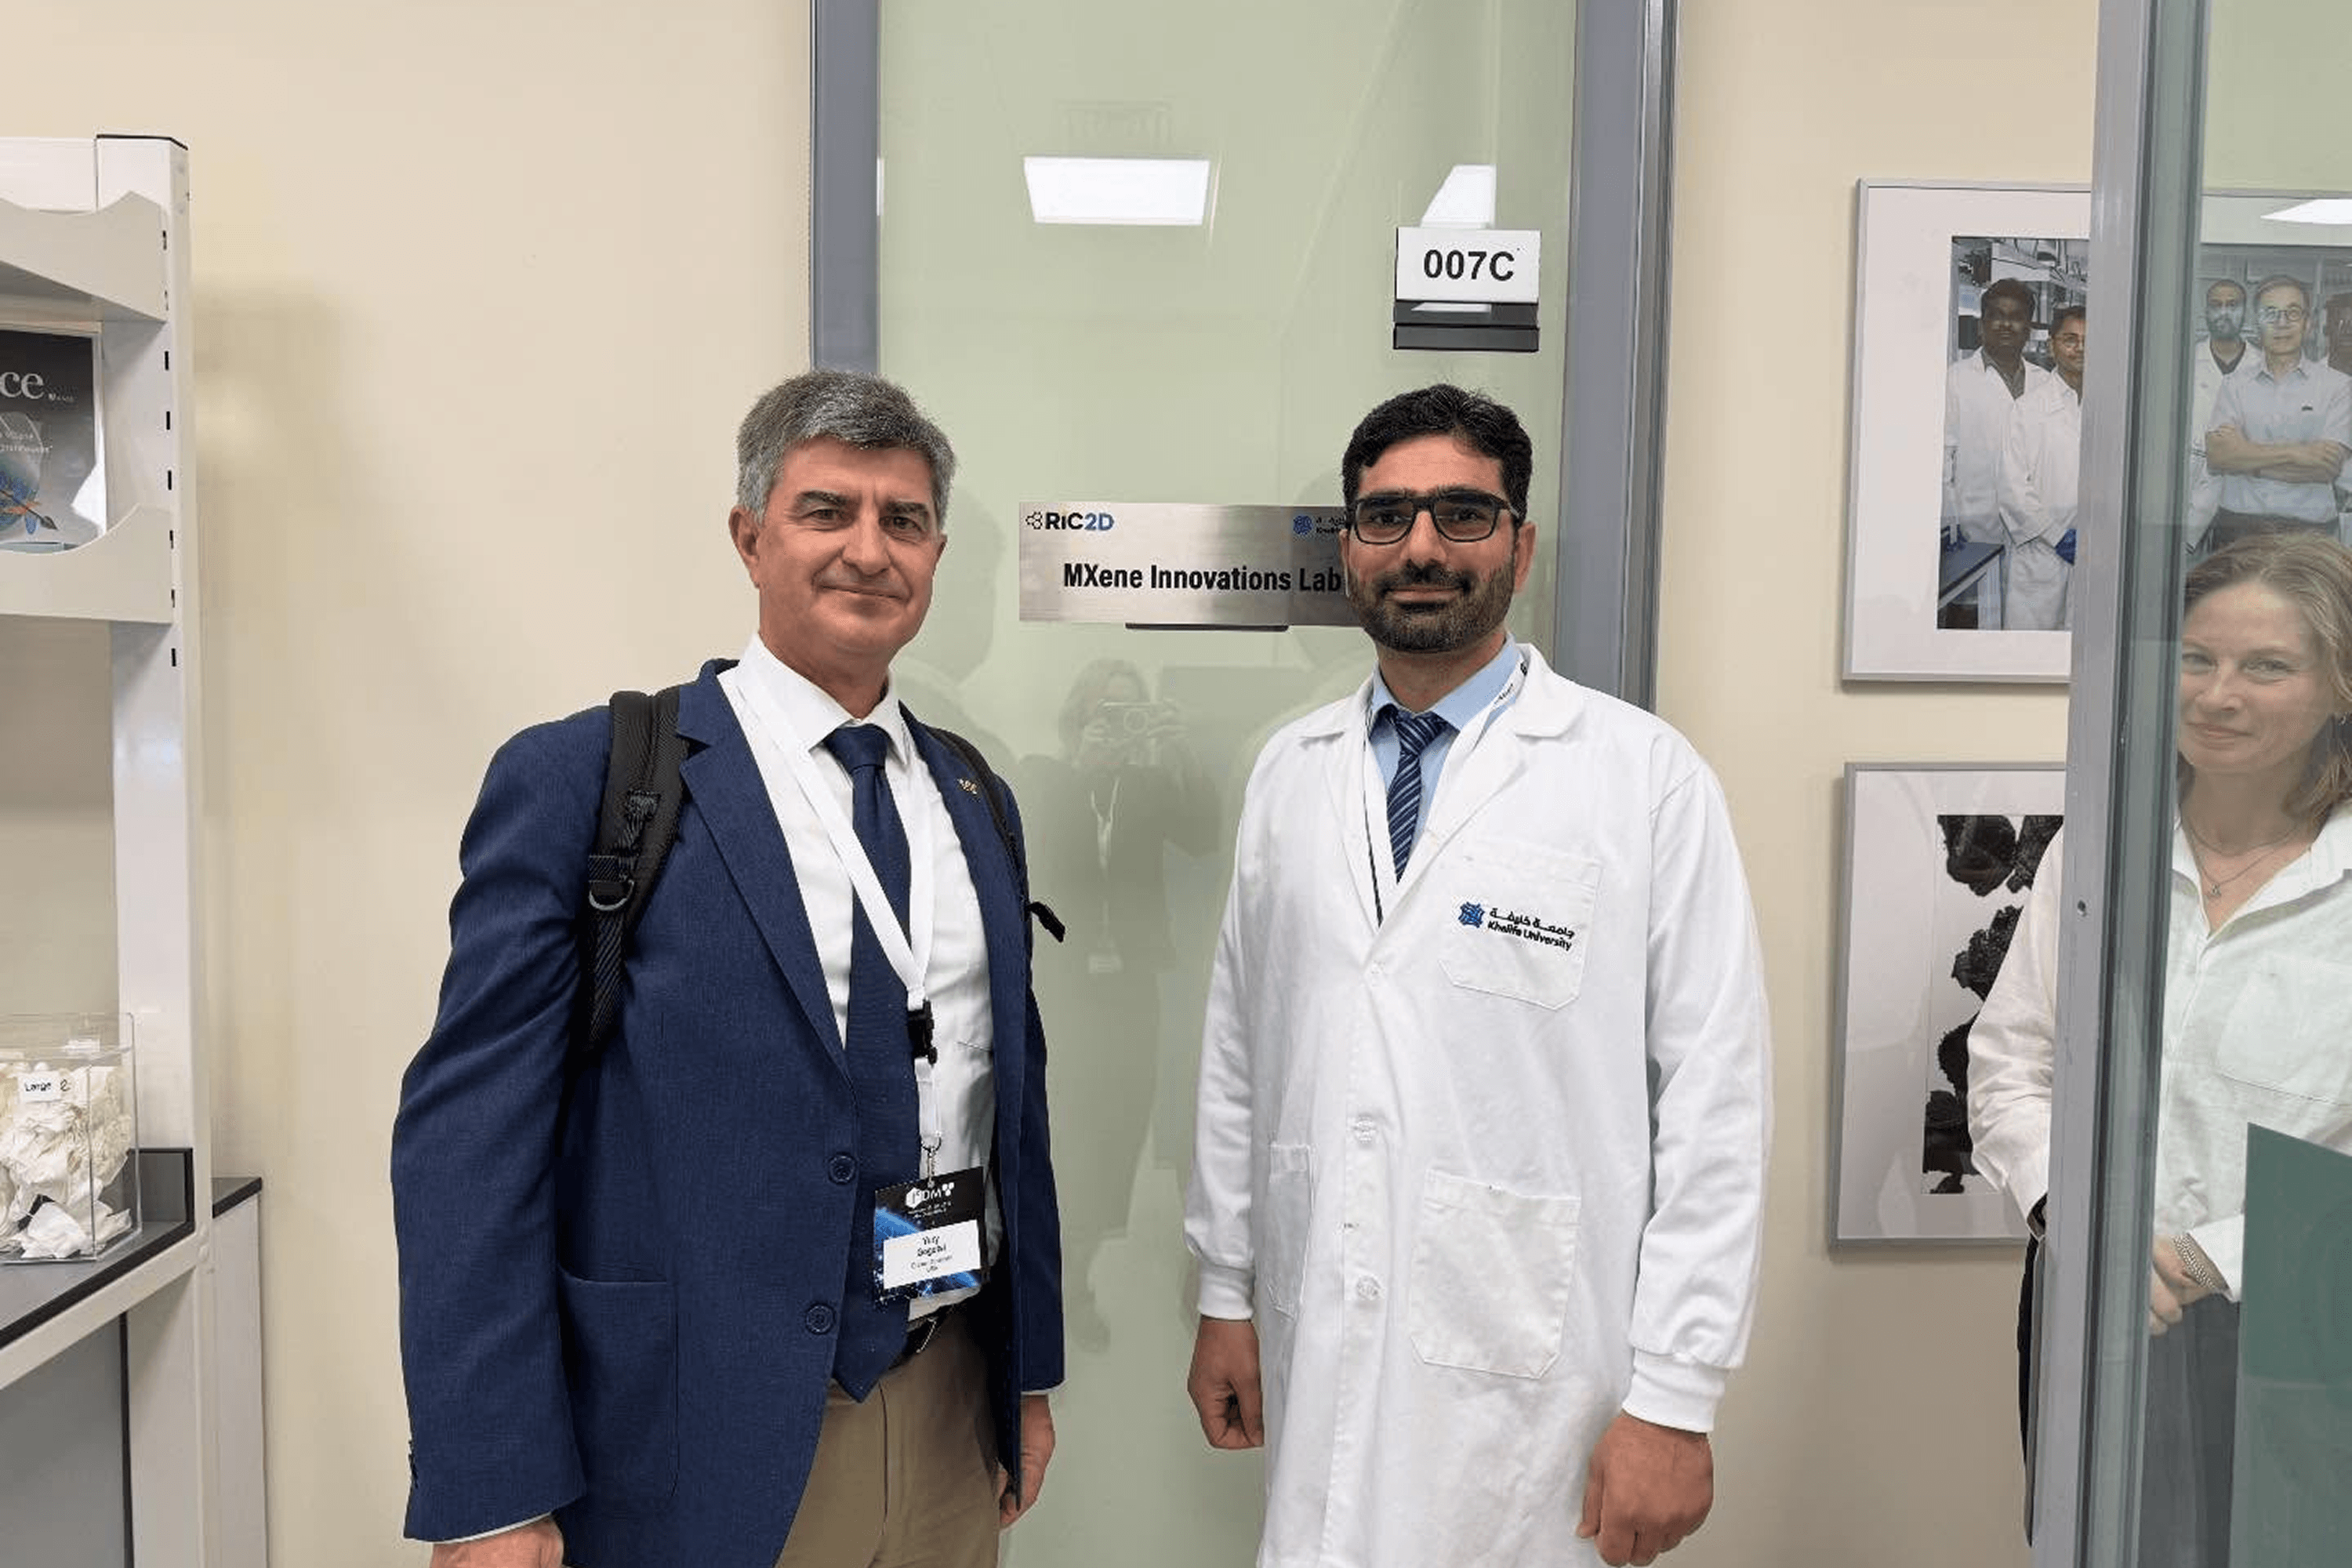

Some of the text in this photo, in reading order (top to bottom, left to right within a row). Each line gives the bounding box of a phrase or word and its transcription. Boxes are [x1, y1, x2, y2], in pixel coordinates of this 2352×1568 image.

[1424, 249, 1515, 281] 007C
[1063, 563, 1342, 593] MXene Innovations Lab
[1487, 920, 1573, 952] Khalifa University
